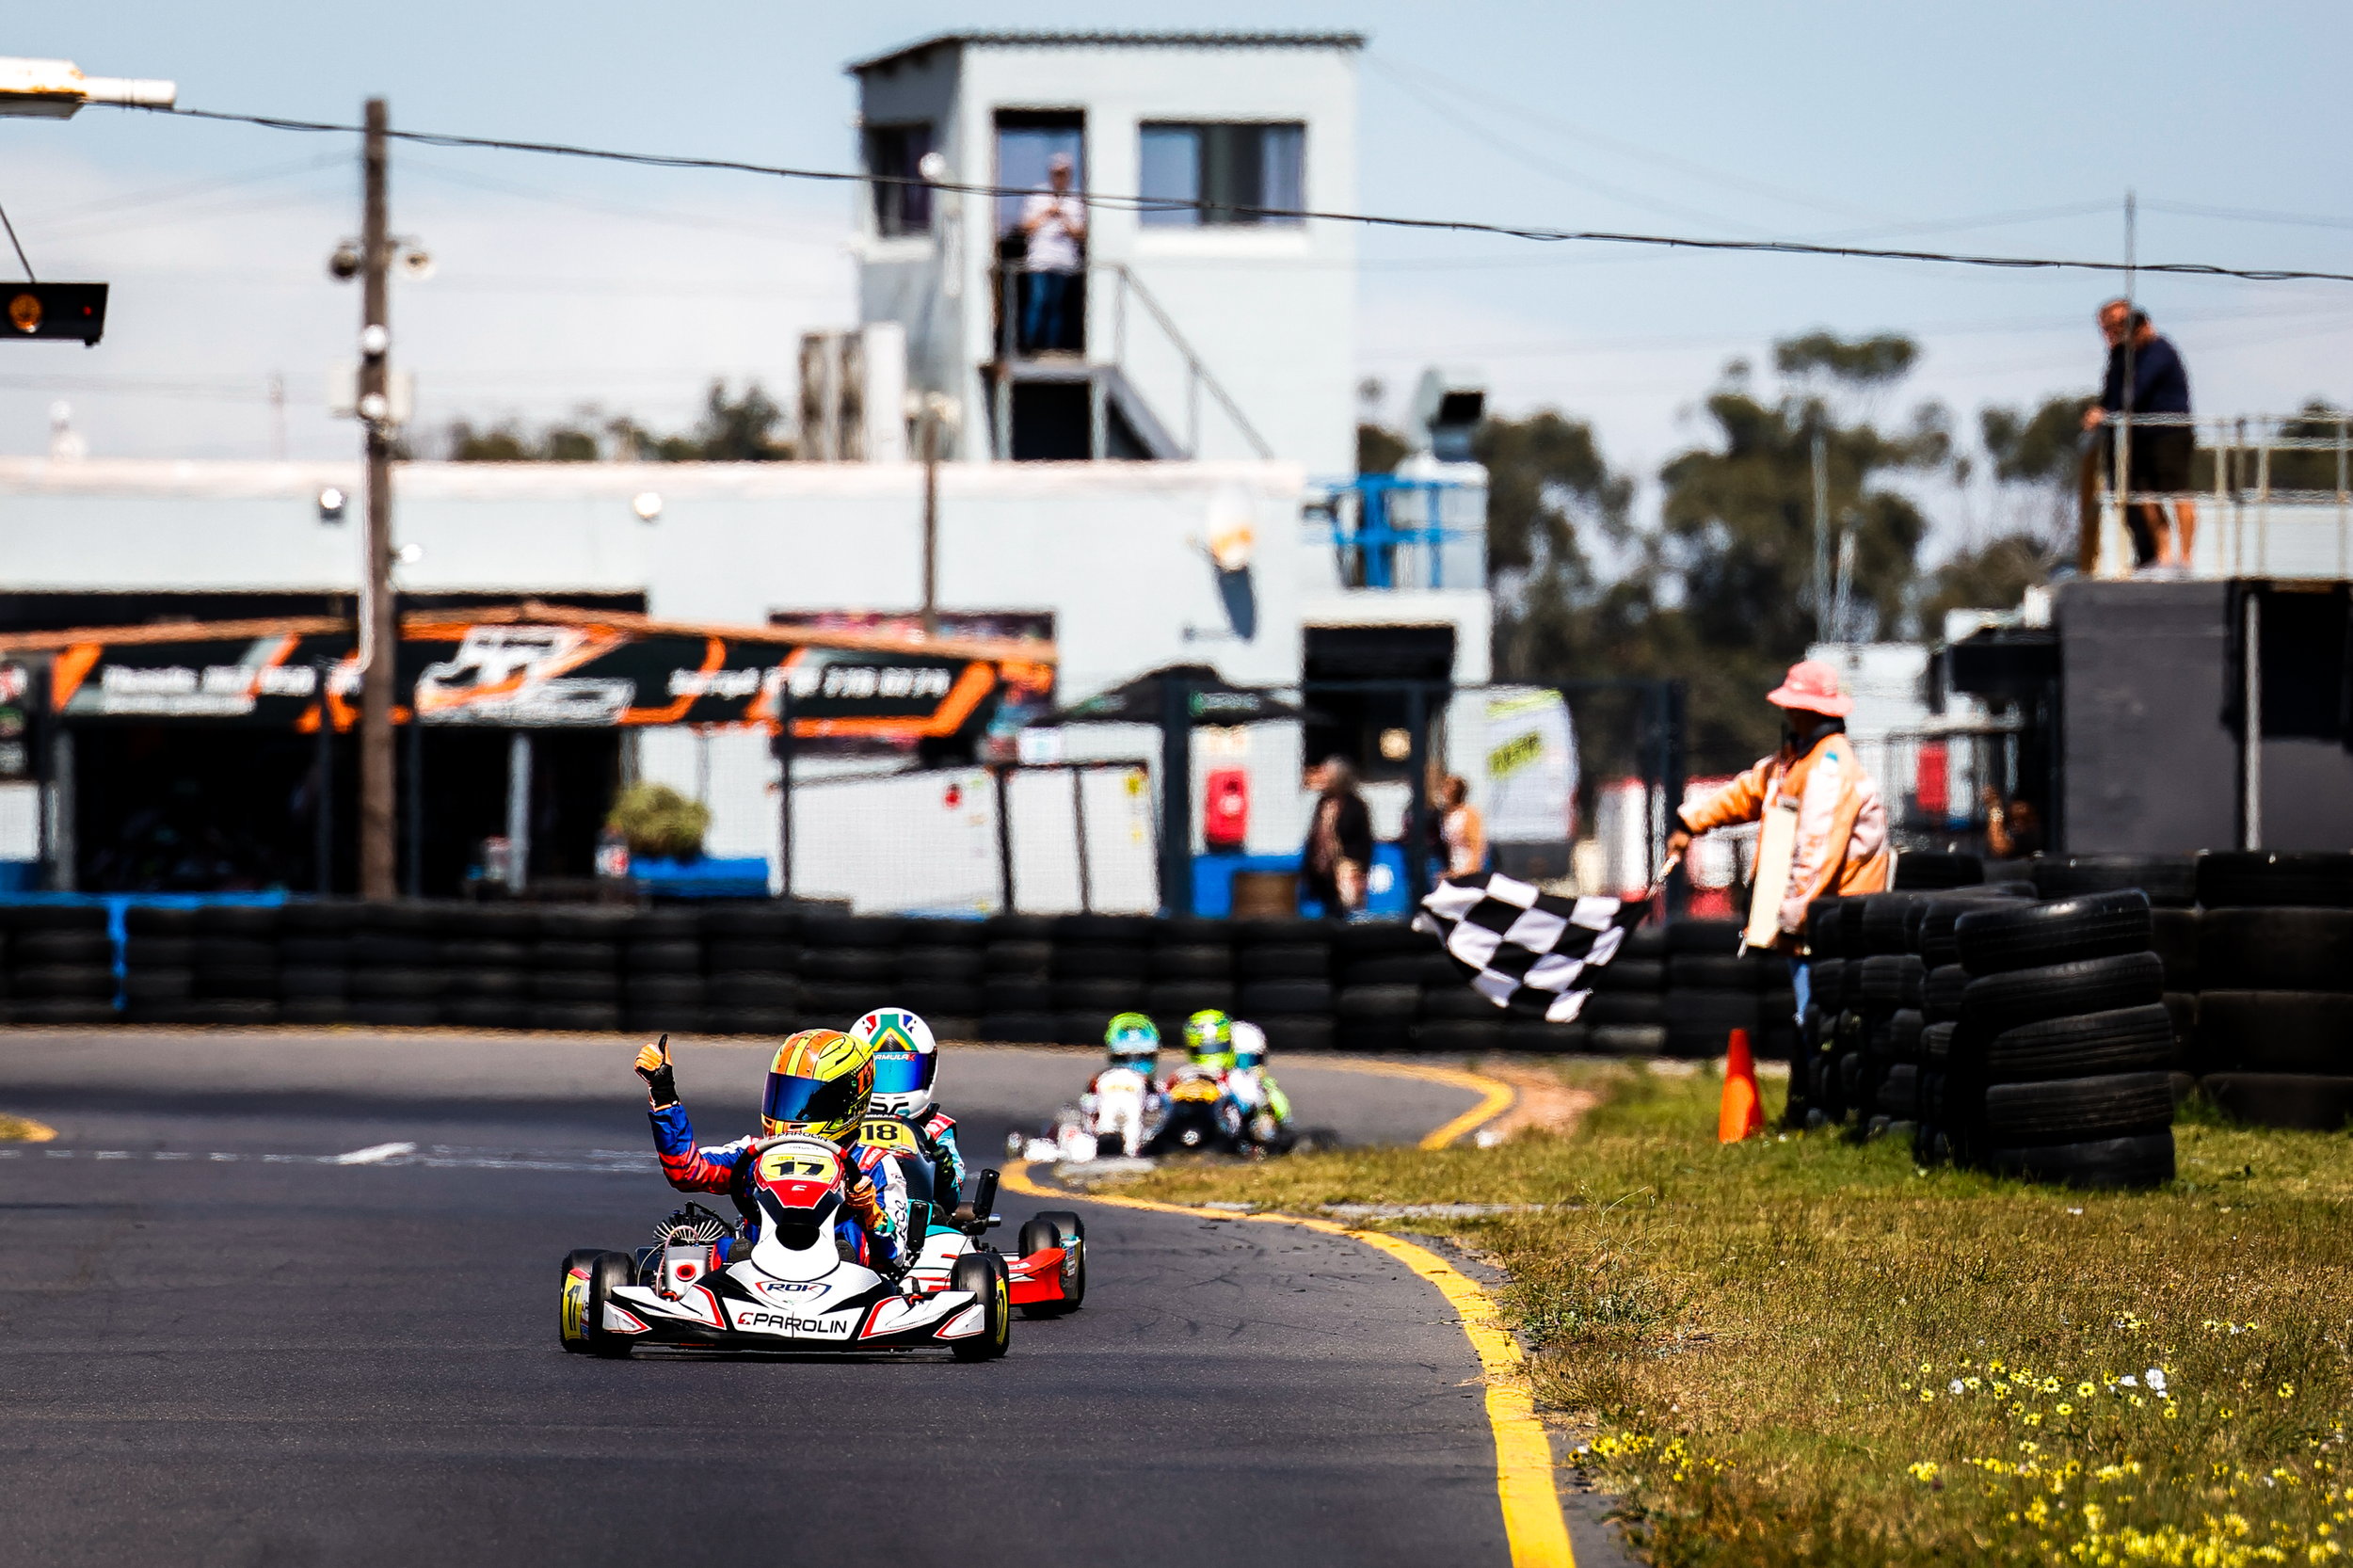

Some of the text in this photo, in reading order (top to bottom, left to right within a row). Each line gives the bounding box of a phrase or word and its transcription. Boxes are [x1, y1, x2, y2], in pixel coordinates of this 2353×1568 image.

[776, 1131, 829, 1143] PAROLIN
[861, 1124, 899, 1141] 18
[771, 1161, 824, 1176] 17
[767, 1283, 820, 1295] ROK
[753, 1312, 848, 1334] PAROLIN
